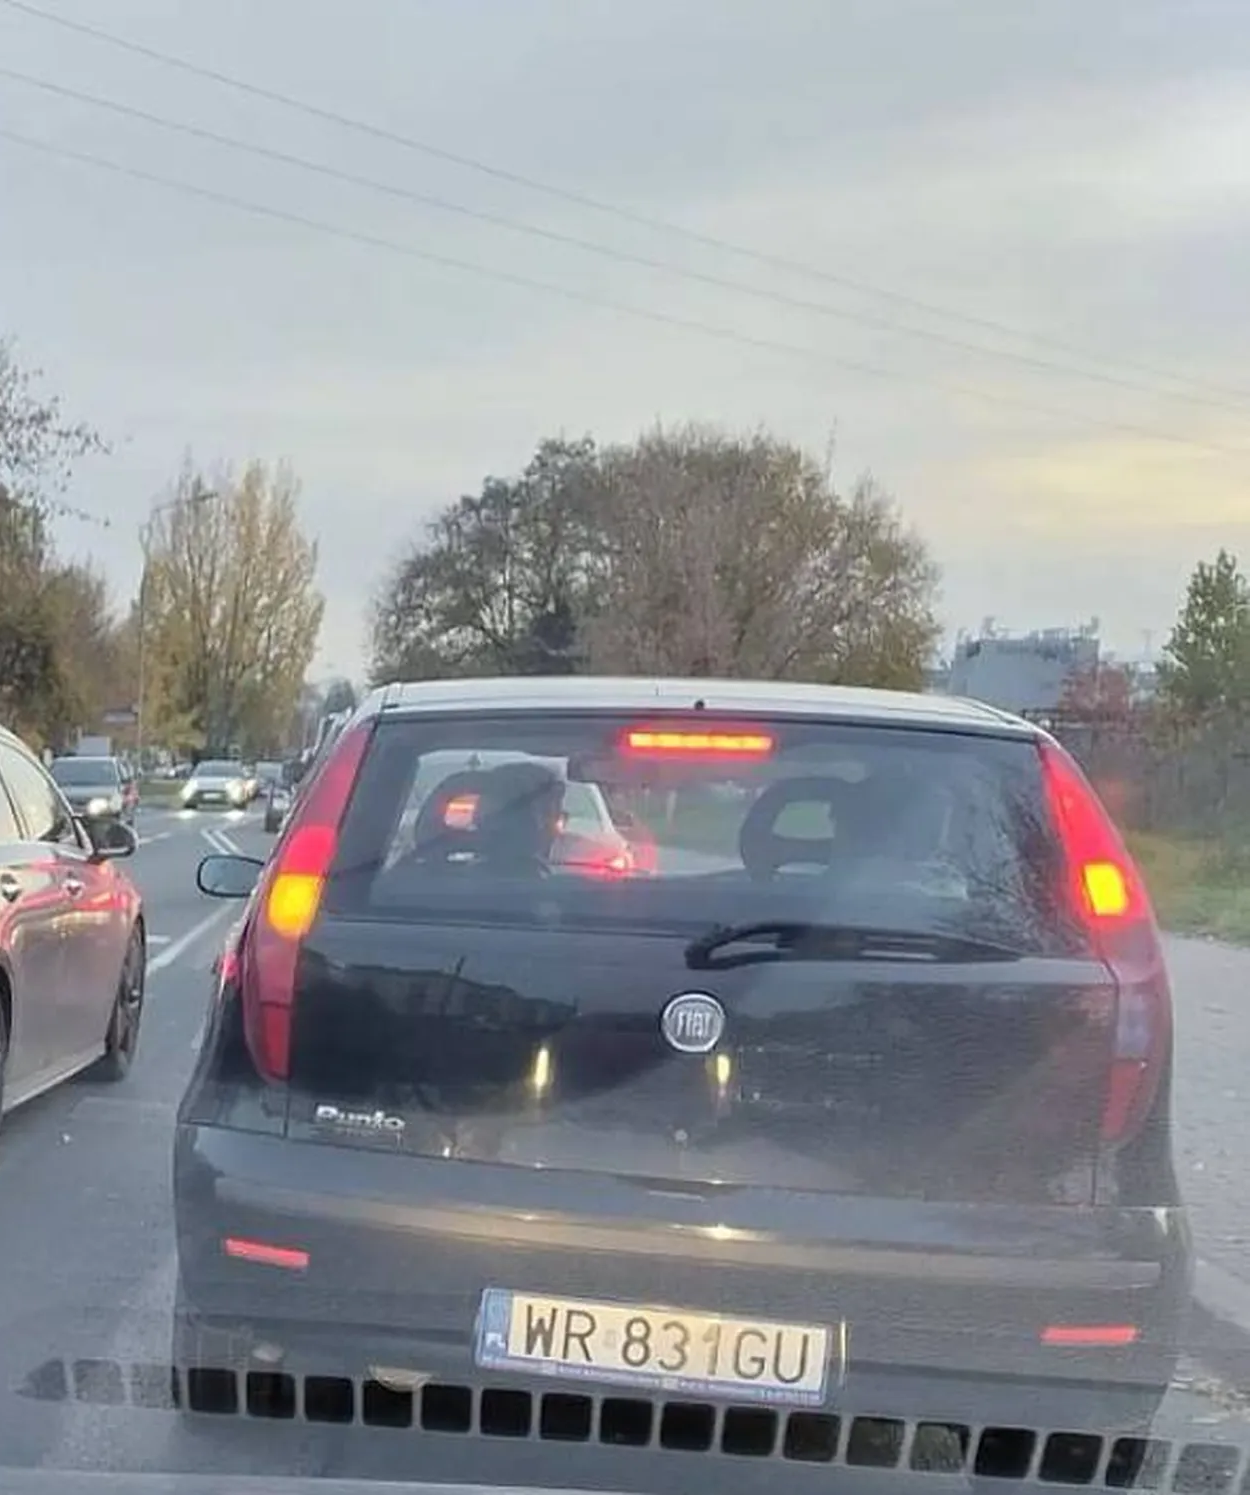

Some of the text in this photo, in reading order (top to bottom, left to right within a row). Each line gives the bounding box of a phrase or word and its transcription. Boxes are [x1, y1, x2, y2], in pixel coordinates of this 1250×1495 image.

[316, 1104, 405, 1130] Punto
[525, 1304, 596, 1363] WR
[622, 1317, 809, 1384] 831GU
